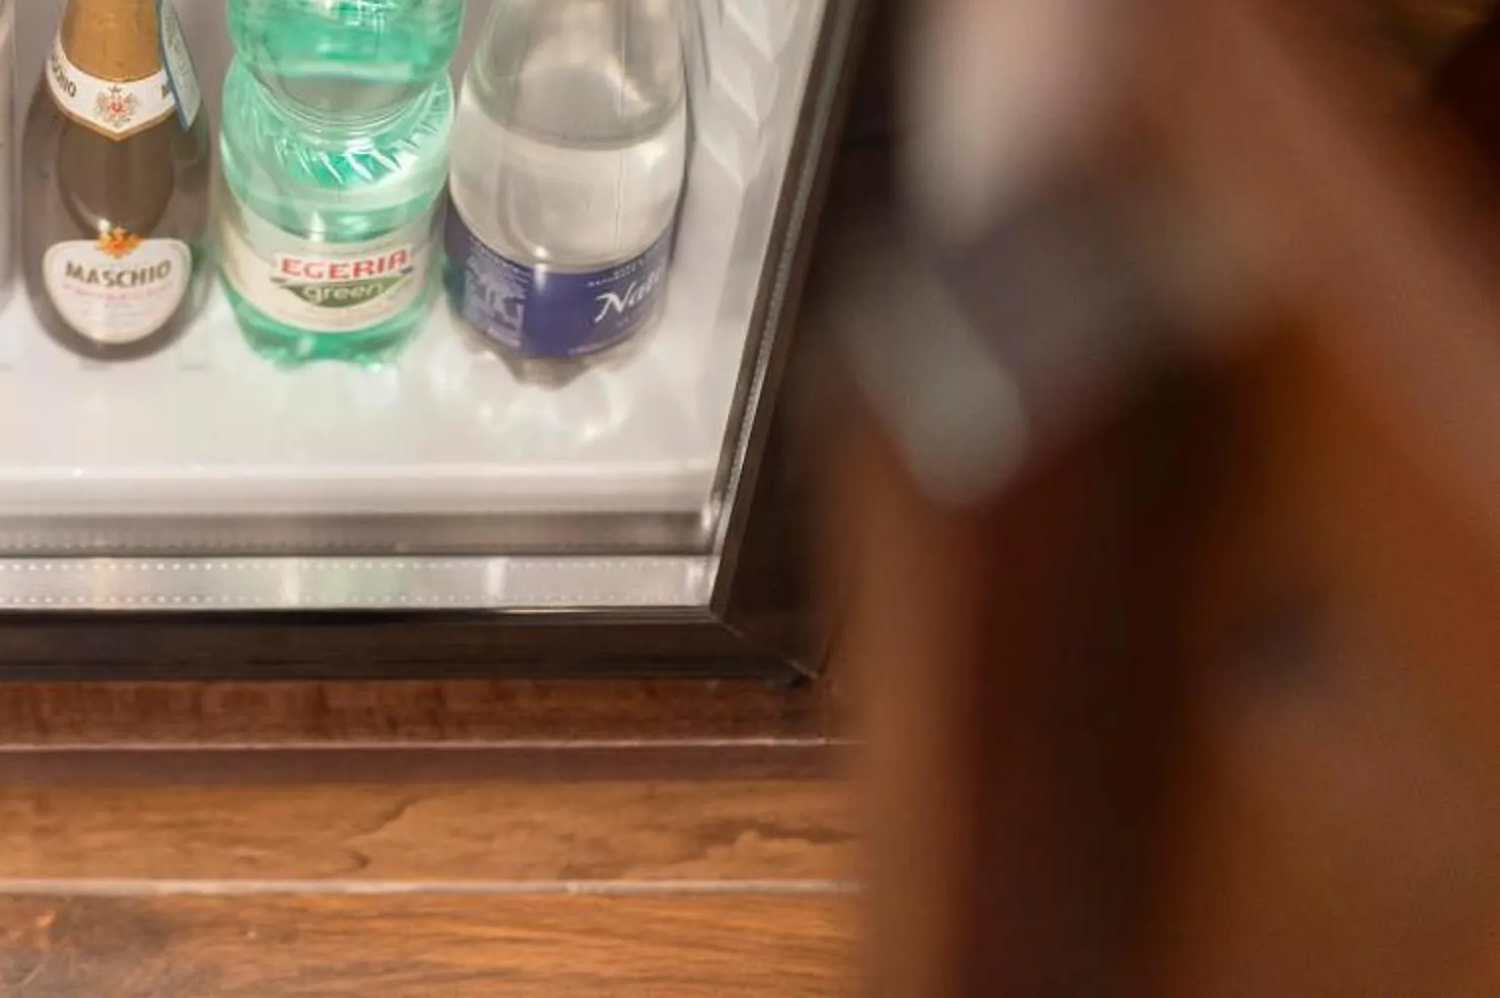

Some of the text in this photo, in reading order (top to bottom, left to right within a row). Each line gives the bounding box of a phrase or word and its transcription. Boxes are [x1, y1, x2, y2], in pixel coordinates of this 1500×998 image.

[65, 259, 172, 288] MASCHIO
[281, 249, 408, 280] EGERIA
[302, 282, 384, 304] green
